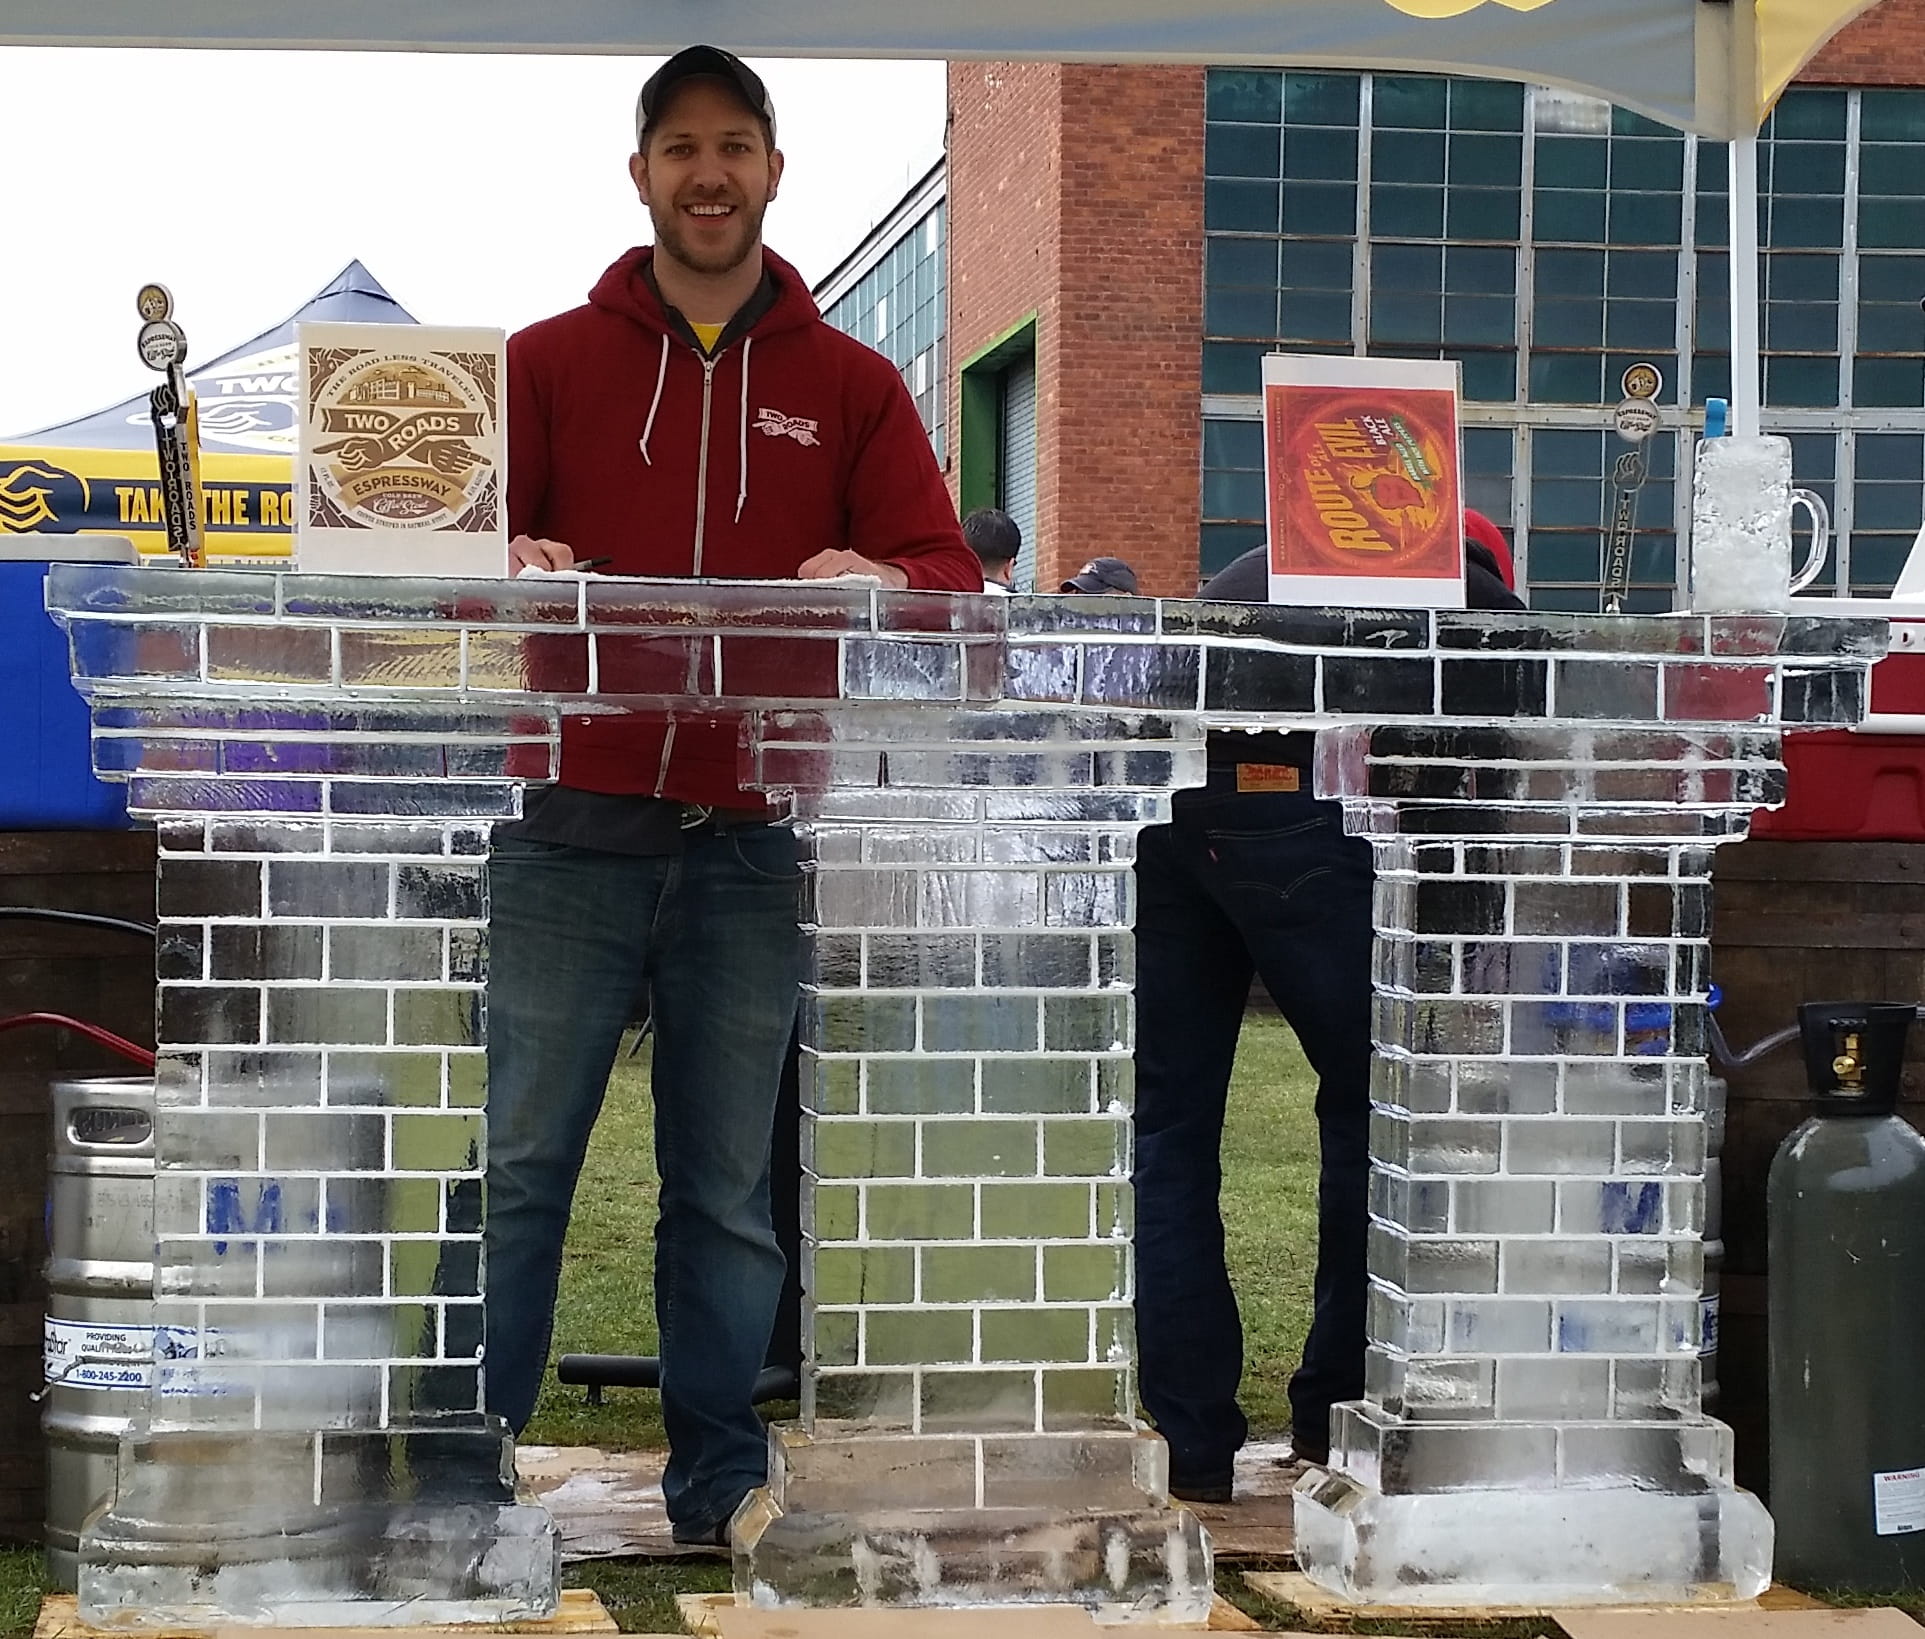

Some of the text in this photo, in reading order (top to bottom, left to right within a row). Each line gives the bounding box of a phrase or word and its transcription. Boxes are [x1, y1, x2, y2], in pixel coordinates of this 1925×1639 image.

[327, 354, 476, 402] THE ROAD LESS TRAVELED
[344, 414, 461, 451] TWO ROADS
[766, 411, 810, 430] TWO ROADS
[1314, 417, 1380, 458] EVIL
[1361, 415, 1395, 446] BLACK ALE
[179, 442, 196, 531] TWO ROADS
[352, 475, 451, 497] ESPRESSWAY
[115, 487, 297, 527] TAK THE RO
[1303, 468, 1394, 551] ROUTE
[86, 1332, 126, 1342] PROVIDING
[75, 1368, 142, 1381] 1-800-245-2200
[1883, 1471, 1920, 1482] WARNING
